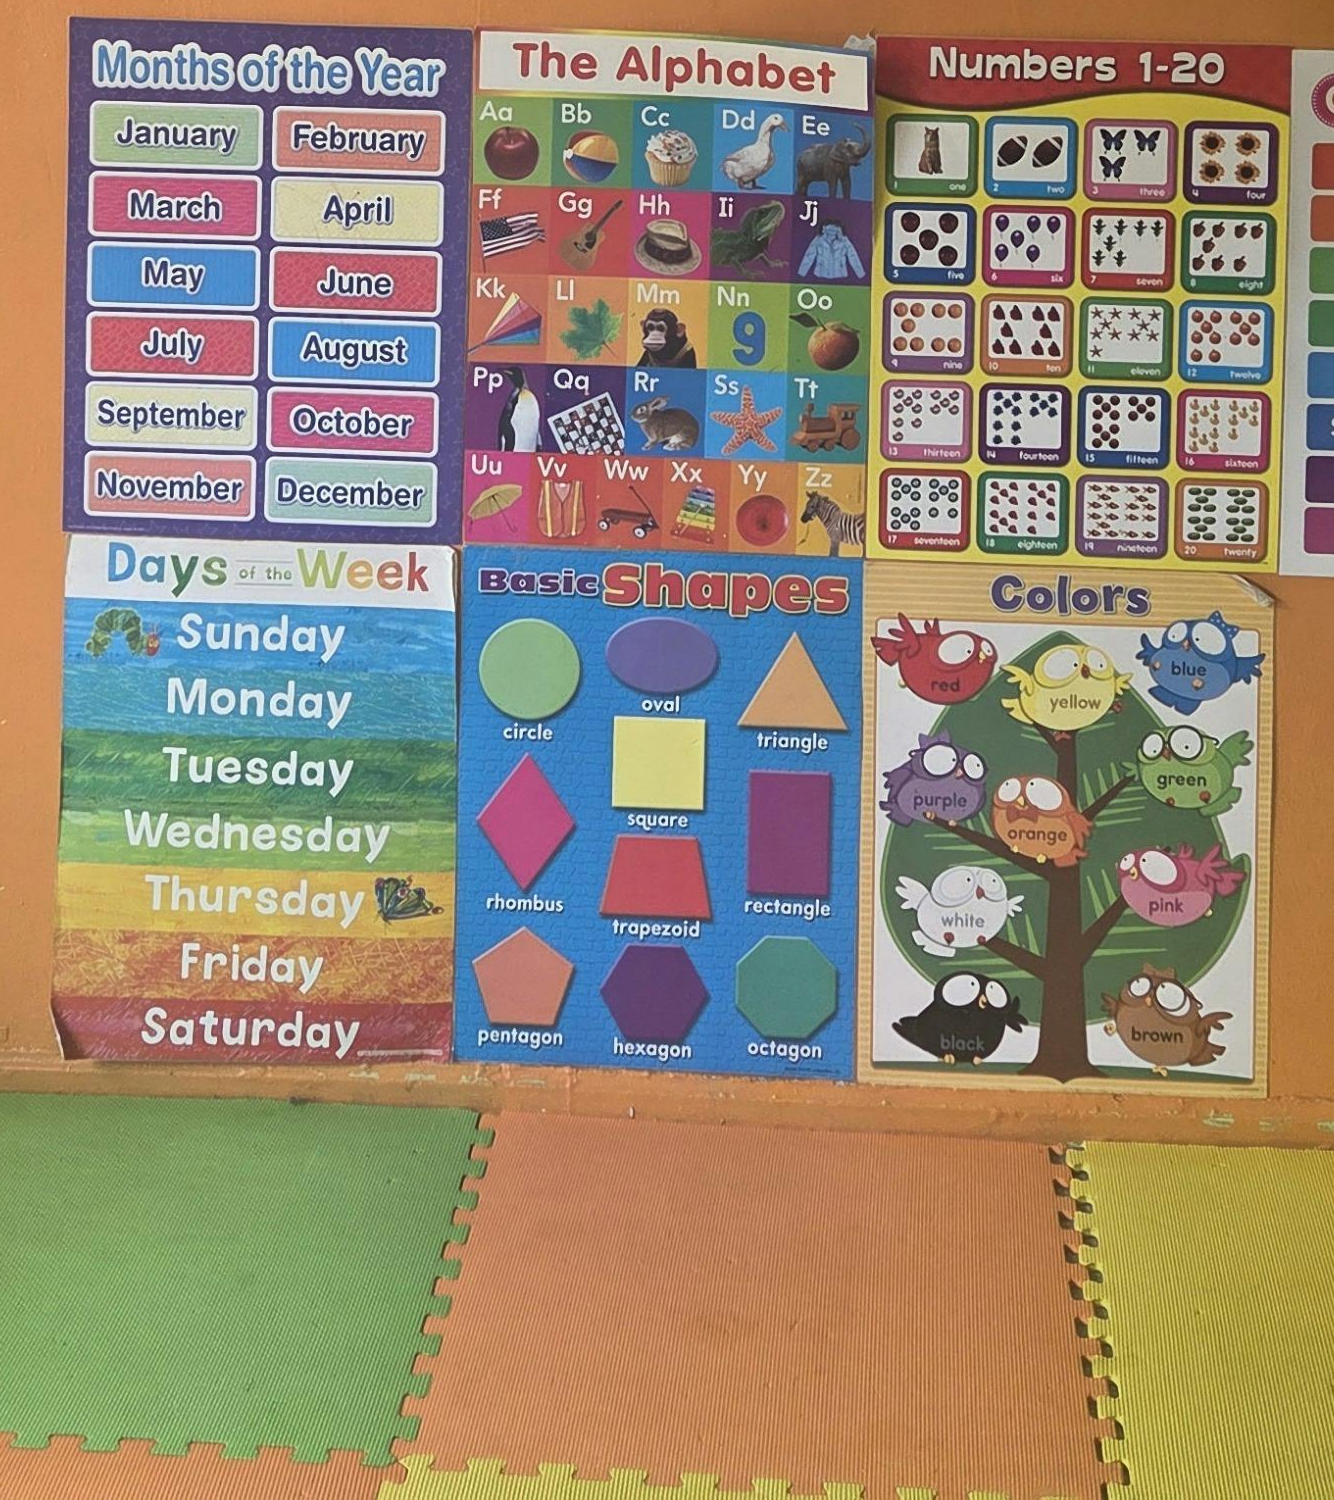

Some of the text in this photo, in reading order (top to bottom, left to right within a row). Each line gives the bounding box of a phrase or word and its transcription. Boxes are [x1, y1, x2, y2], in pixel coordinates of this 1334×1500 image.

[96, 44, 441, 94] Months of the Year
[513, 43, 836, 93] The Alphabet
[929, 46, 1226, 83] Numbers 1-20
[479, 105, 513, 123] Aa
[561, 105, 592, 125] Bb
[641, 107, 670, 126] Cc
[722, 111, 755, 131] Dd
[117, 119, 238, 153] January
[803, 118, 831, 136] Ee
[292, 124, 425, 160] February
[130, 192, 222, 220] March
[478, 190, 503, 209] Ff
[559, 193, 593, 217] Gg
[639, 196, 671, 215] Hh
[718, 198, 734, 217] Ii
[323, 196, 393, 229] April
[799, 203, 818, 226] Jj
[144, 260, 205, 292] May
[319, 269, 392, 297] June
[476, 279, 505, 299] Kk
[556, 280, 575, 301] Ll
[637, 284, 680, 304] Mm
[717, 287, 749, 308] Nn
[797, 289, 833, 309] Oo
[142, 331, 203, 362] July
[734, 312, 766, 365] 9
[303, 336, 407, 367] August
[474, 368, 503, 390] Pp
[553, 371, 589, 395] Qq
[634, 372, 659, 392] Rr
[713, 376, 739, 395] Ss
[795, 378, 818, 399] Tt
[97, 400, 245, 432] September
[293, 409, 413, 437] October
[472, 455, 503, 475] Uu
[538, 457, 567, 477] Vv
[604, 460, 650, 481] Ww
[671, 462, 702, 483] Xx
[97, 472, 243, 502] November
[739, 466, 768, 487] Yy
[805, 468, 832, 487] Zz
[277, 478, 423, 509] December
[107, 542, 430, 598] Days of the Week
[479, 563, 850, 617] Basic Shapes
[991, 575, 1151, 617] Colors
[177, 613, 345, 664] Sunday
[1171, 662, 1207, 678] blue
[930, 677, 960, 694] red
[166, 678, 352, 729] Monday
[641, 696, 681, 713] oval
[1049, 694, 1101, 712] yellow
[503, 724, 554, 741] circle
[756, 733, 829, 753] triangle
[163, 746, 354, 797] Tuesday
[1156, 772, 1207, 790] green
[912, 791, 967, 810] purple
[627, 812, 688, 830] square
[124, 809, 390, 863] Wednesday
[1007, 827, 1068, 846] orange
[145, 874, 365, 929] Thursday
[486, 894, 564, 913] rhombus
[744, 898, 830, 918] rectangle
[1148, 898, 1184, 916] pink
[612, 920, 701, 940] trapezoid
[941, 914, 985, 930] white
[180, 943, 324, 993] Friday
[142, 1007, 360, 1058] Saturday
[478, 1026, 564, 1047] pentagon
[1131, 1027, 1184, 1044] brown
[613, 1038, 692, 1059] hexagon
[747, 1041, 822, 1060] octagon
[940, 1035, 985, 1052] black
